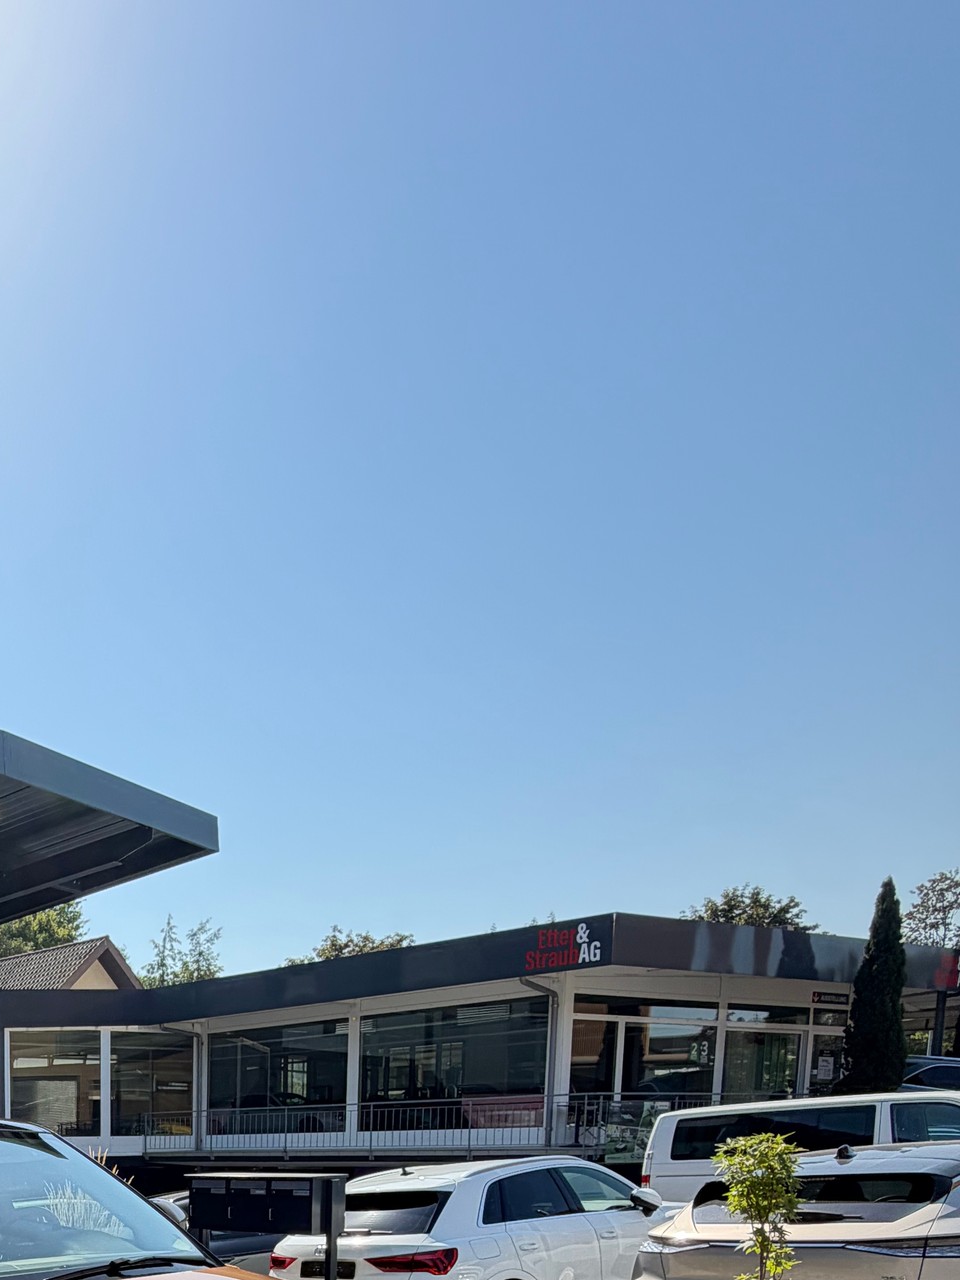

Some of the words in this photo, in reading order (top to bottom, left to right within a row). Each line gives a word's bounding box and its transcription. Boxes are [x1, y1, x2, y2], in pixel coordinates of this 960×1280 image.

[538, 928, 577, 949] Etter
[576, 922, 590, 943] &
[525, 946, 579, 971] Straub
[578, 941, 601, 964] AG
